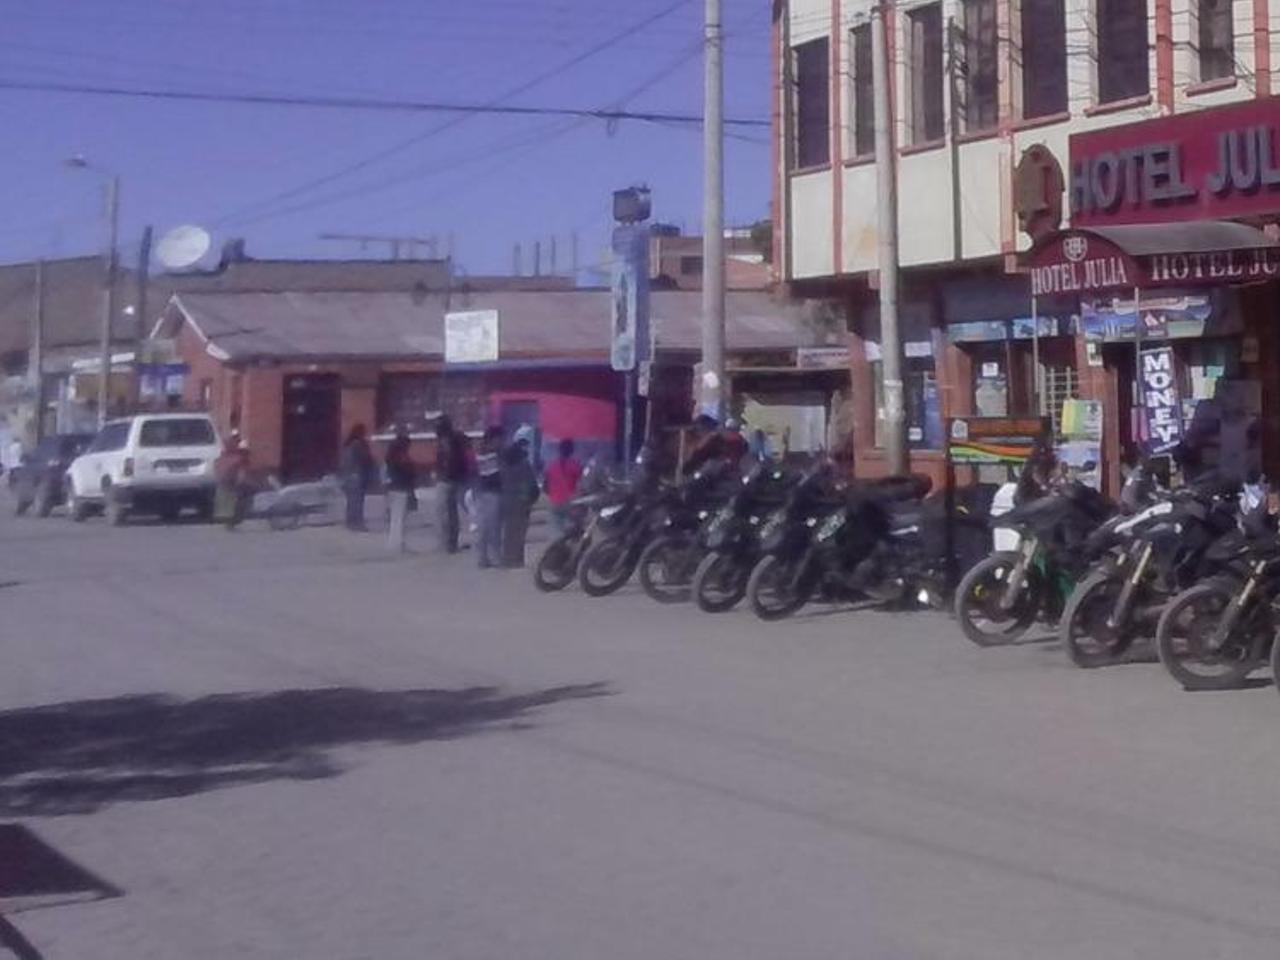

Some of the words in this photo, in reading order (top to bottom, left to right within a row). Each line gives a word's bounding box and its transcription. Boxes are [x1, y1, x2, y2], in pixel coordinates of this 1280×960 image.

[1070, 143, 1197, 214] HOTEL
[1031, 261, 1081, 296] HOTEL
[1083, 256, 1128, 289] JULIA
[1151, 250, 1243, 281] HOTEL
[1142, 352, 1179, 443] MONEY
